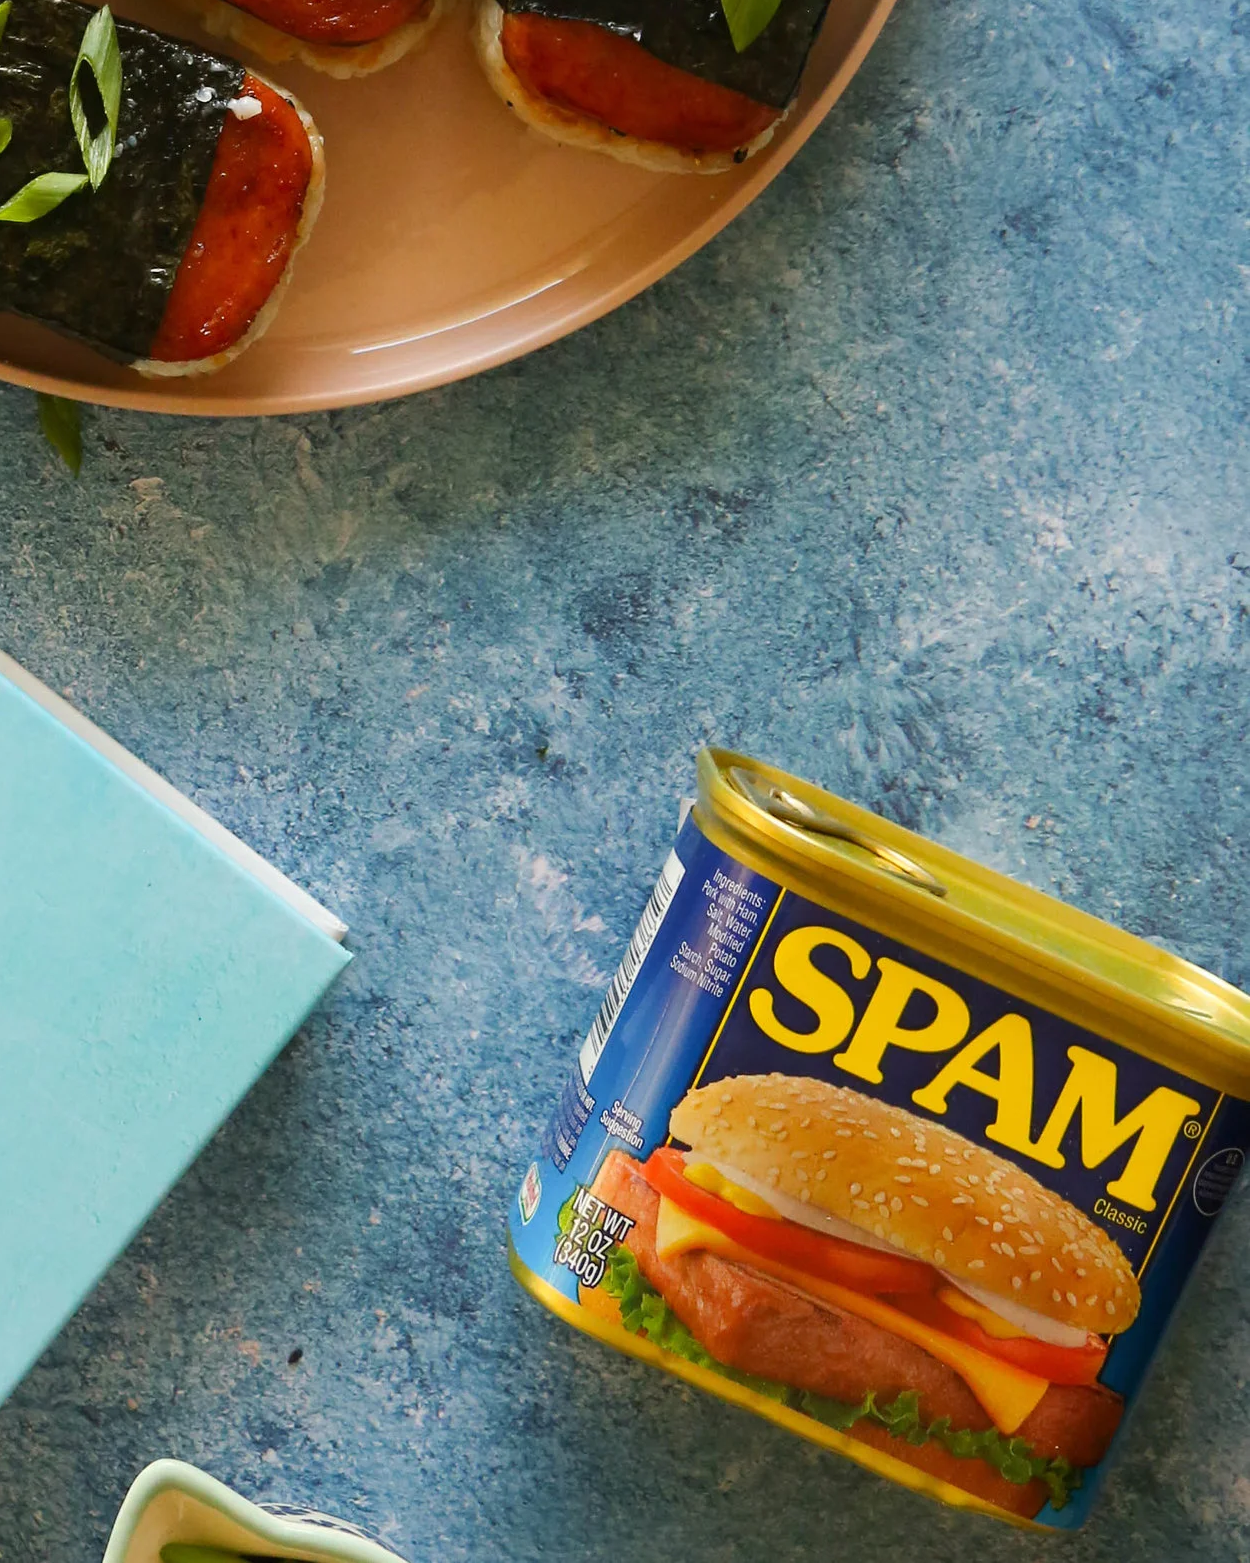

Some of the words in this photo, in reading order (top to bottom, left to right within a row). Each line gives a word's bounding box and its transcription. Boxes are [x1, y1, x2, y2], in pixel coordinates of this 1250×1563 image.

[702, 880, 718, 900] Pork
[718, 892, 735, 911] with
[713, 868, 766, 910] Ingredients:
[707, 922, 744, 953] Modified
[710, 942, 737, 968] Potato
[670, 955, 697, 981] Sodium
[697, 973, 724, 998] Nitrite
[600, 1110, 643, 1149] Suggestion
[611, 1100, 642, 1132] Serving
[573, 1188, 605, 1223] NET
[603, 1208, 634, 1240] WT
[1093, 1198, 1147, 1234] Classic
[570, 1218, 589, 1245] 12
[588, 1230, 613, 1260] OZ
[554, 1236, 605, 1286] (340g)
